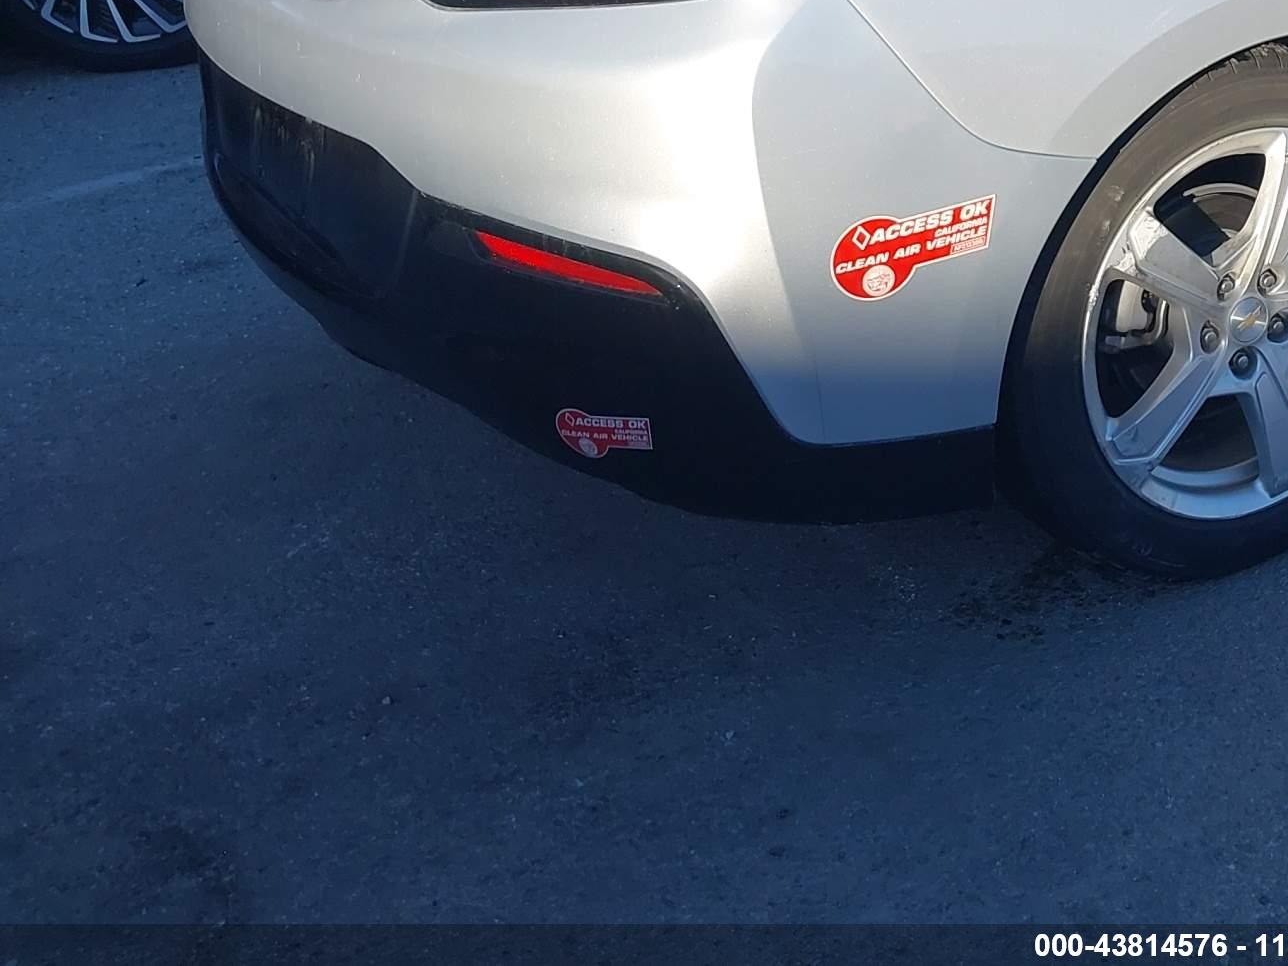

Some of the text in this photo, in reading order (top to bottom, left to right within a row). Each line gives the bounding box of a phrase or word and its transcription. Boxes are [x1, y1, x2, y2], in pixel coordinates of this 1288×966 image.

[869, 200, 990, 244] ACCESS OK
[935, 217, 986, 236] CALIFORNIA
[835, 251, 890, 275] CLEAN
[893, 243, 921, 259] AIR
[927, 225, 986, 250] VEHICLE
[575, 417, 646, 429] ACCESS OK
[561, 429, 648, 441] CLEAN AIR VEHICLE
